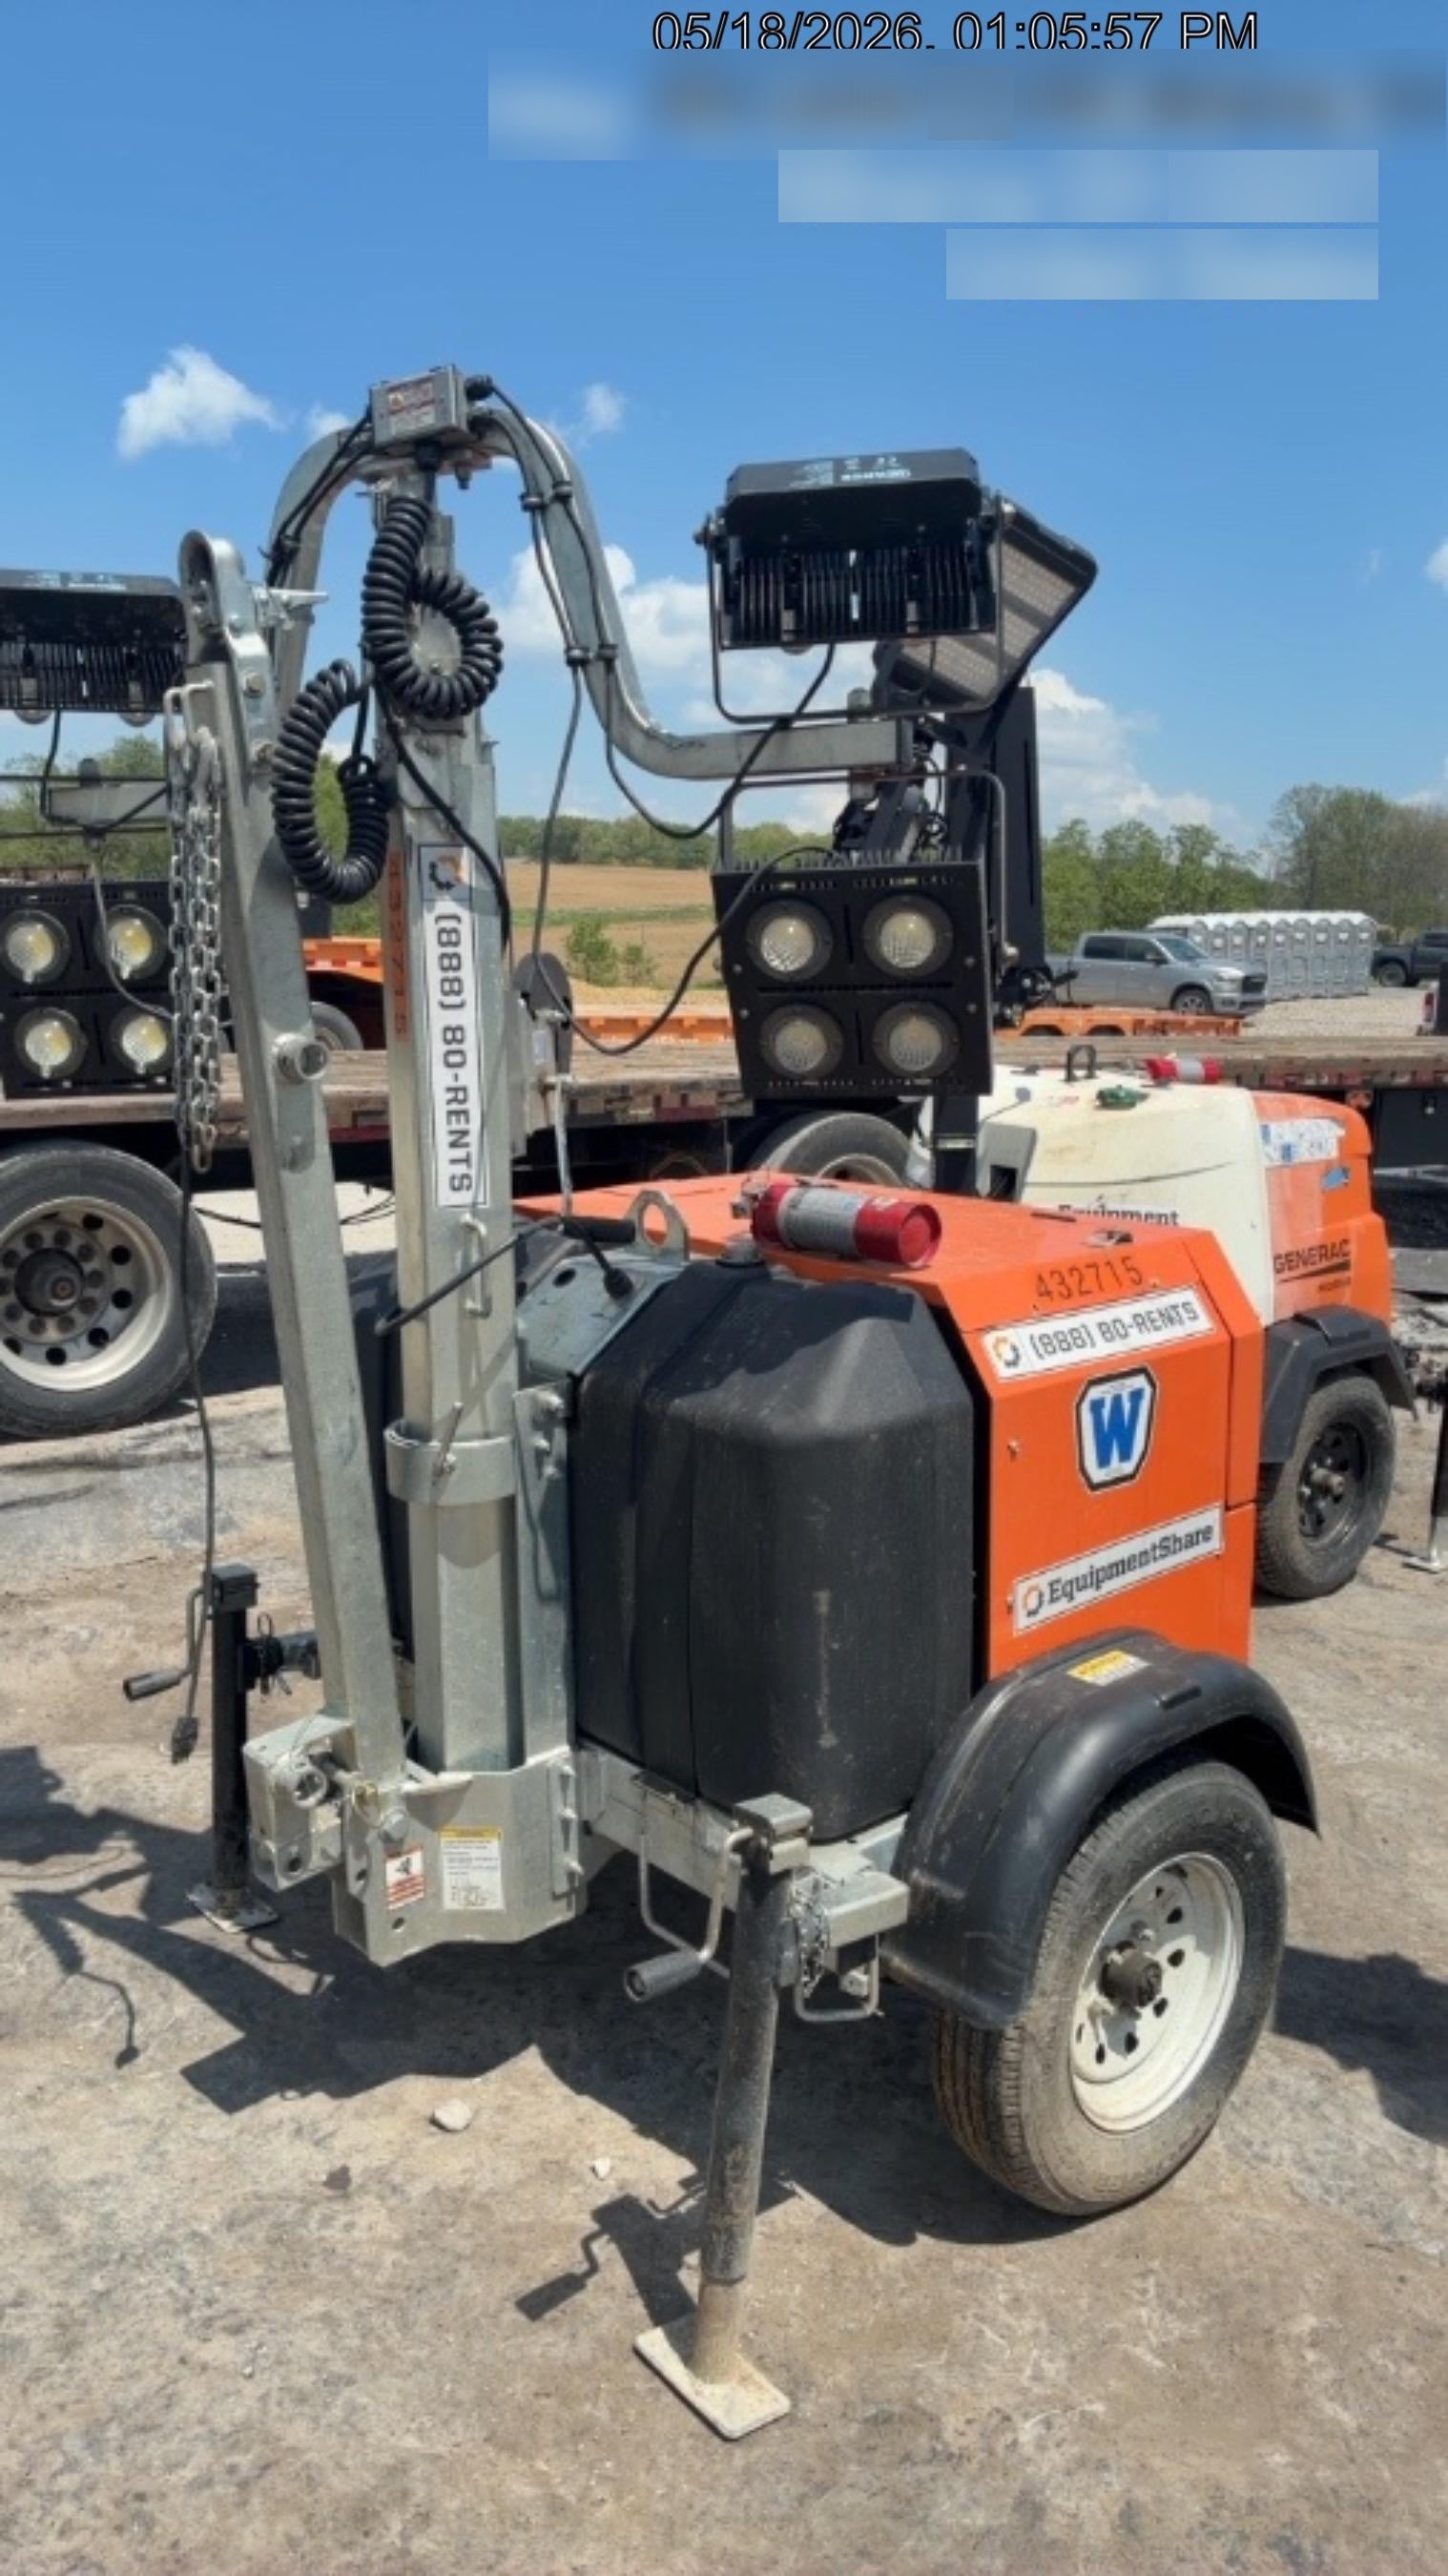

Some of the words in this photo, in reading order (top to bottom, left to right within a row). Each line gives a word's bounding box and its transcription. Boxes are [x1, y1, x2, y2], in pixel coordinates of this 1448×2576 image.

[435, 914, 465, 1010] (888)
[443, 1025, 472, 1193] 80-RENTS
[1036, 1256, 1143, 1302] 432715
[1273, 1238, 1351, 1275] GENERAC
[1029, 1322, 1096, 1360] (888)
[1096, 1301, 1199, 1343] 80-RENTS
[1089, 1387, 1146, 1469] W
[1047, 1525, 1214, 1604] EquipmentShare
